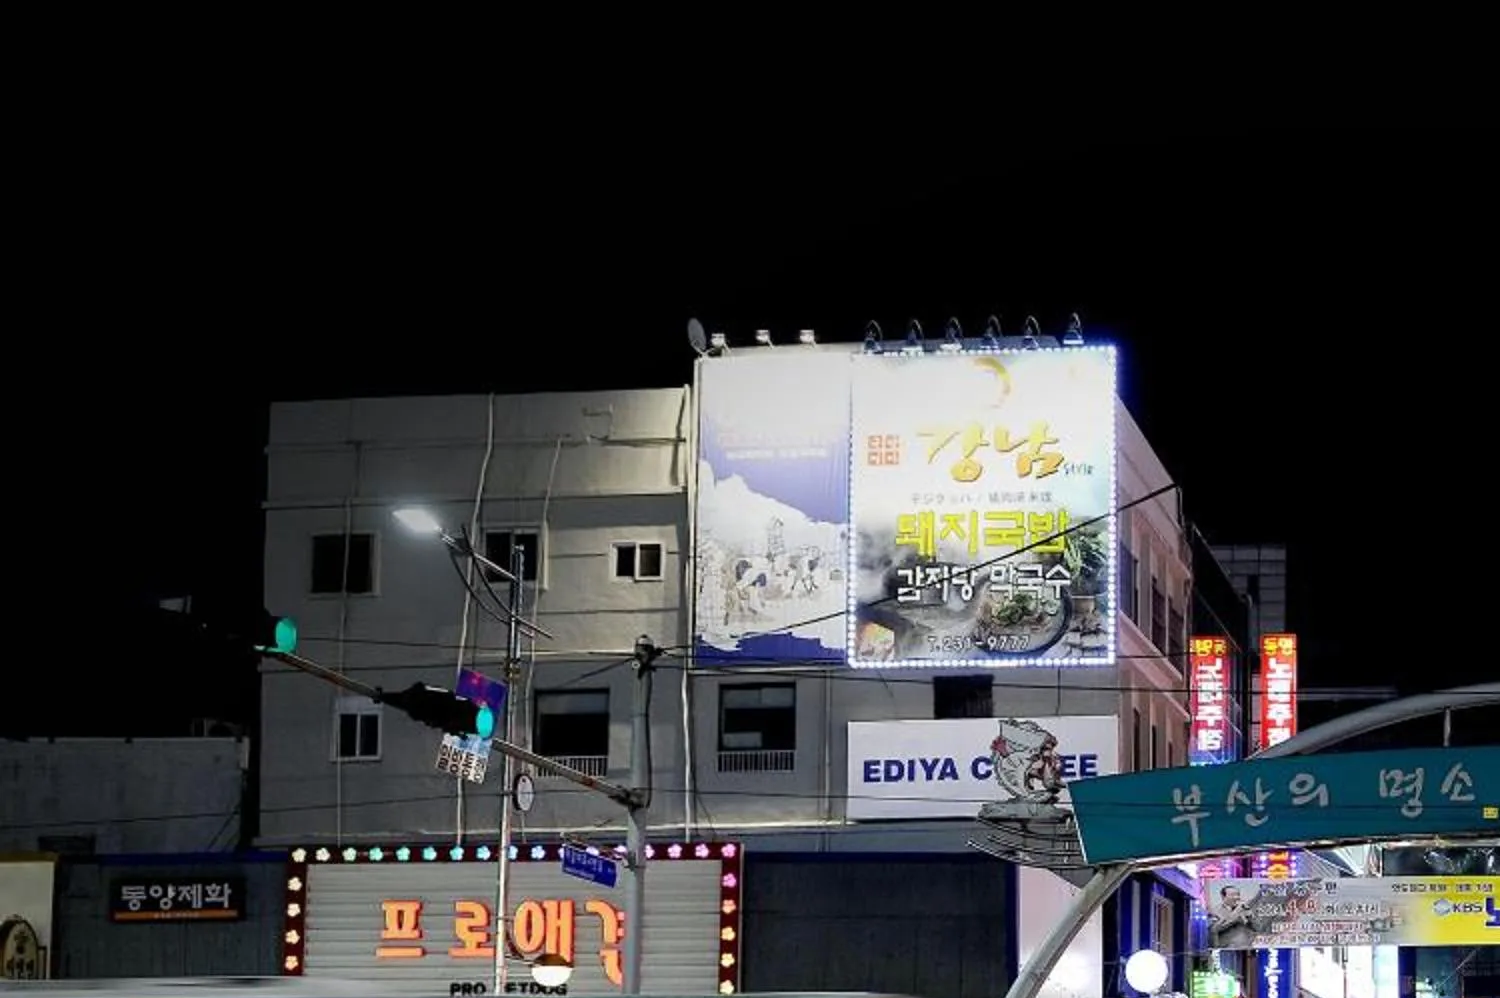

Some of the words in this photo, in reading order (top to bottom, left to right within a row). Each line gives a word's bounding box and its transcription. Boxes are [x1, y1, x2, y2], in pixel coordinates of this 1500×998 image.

[917, 421, 1064, 483] 강남
[896, 510, 1070, 560] 돼지국밥
[990, 562, 1071, 601] 막국수
[863, 758, 960, 784] EDIYA
[971, 753, 1098, 781] CEE
[1170, 772, 1329, 848] 부산의
[1379, 766, 1476, 816] 명소
[120, 883, 233, 912] 동양제화
[1452, 904, 1482, 914] KBS
[449, 983, 487, 996] PRO
[498, 982, 568, 996] ETDOG
